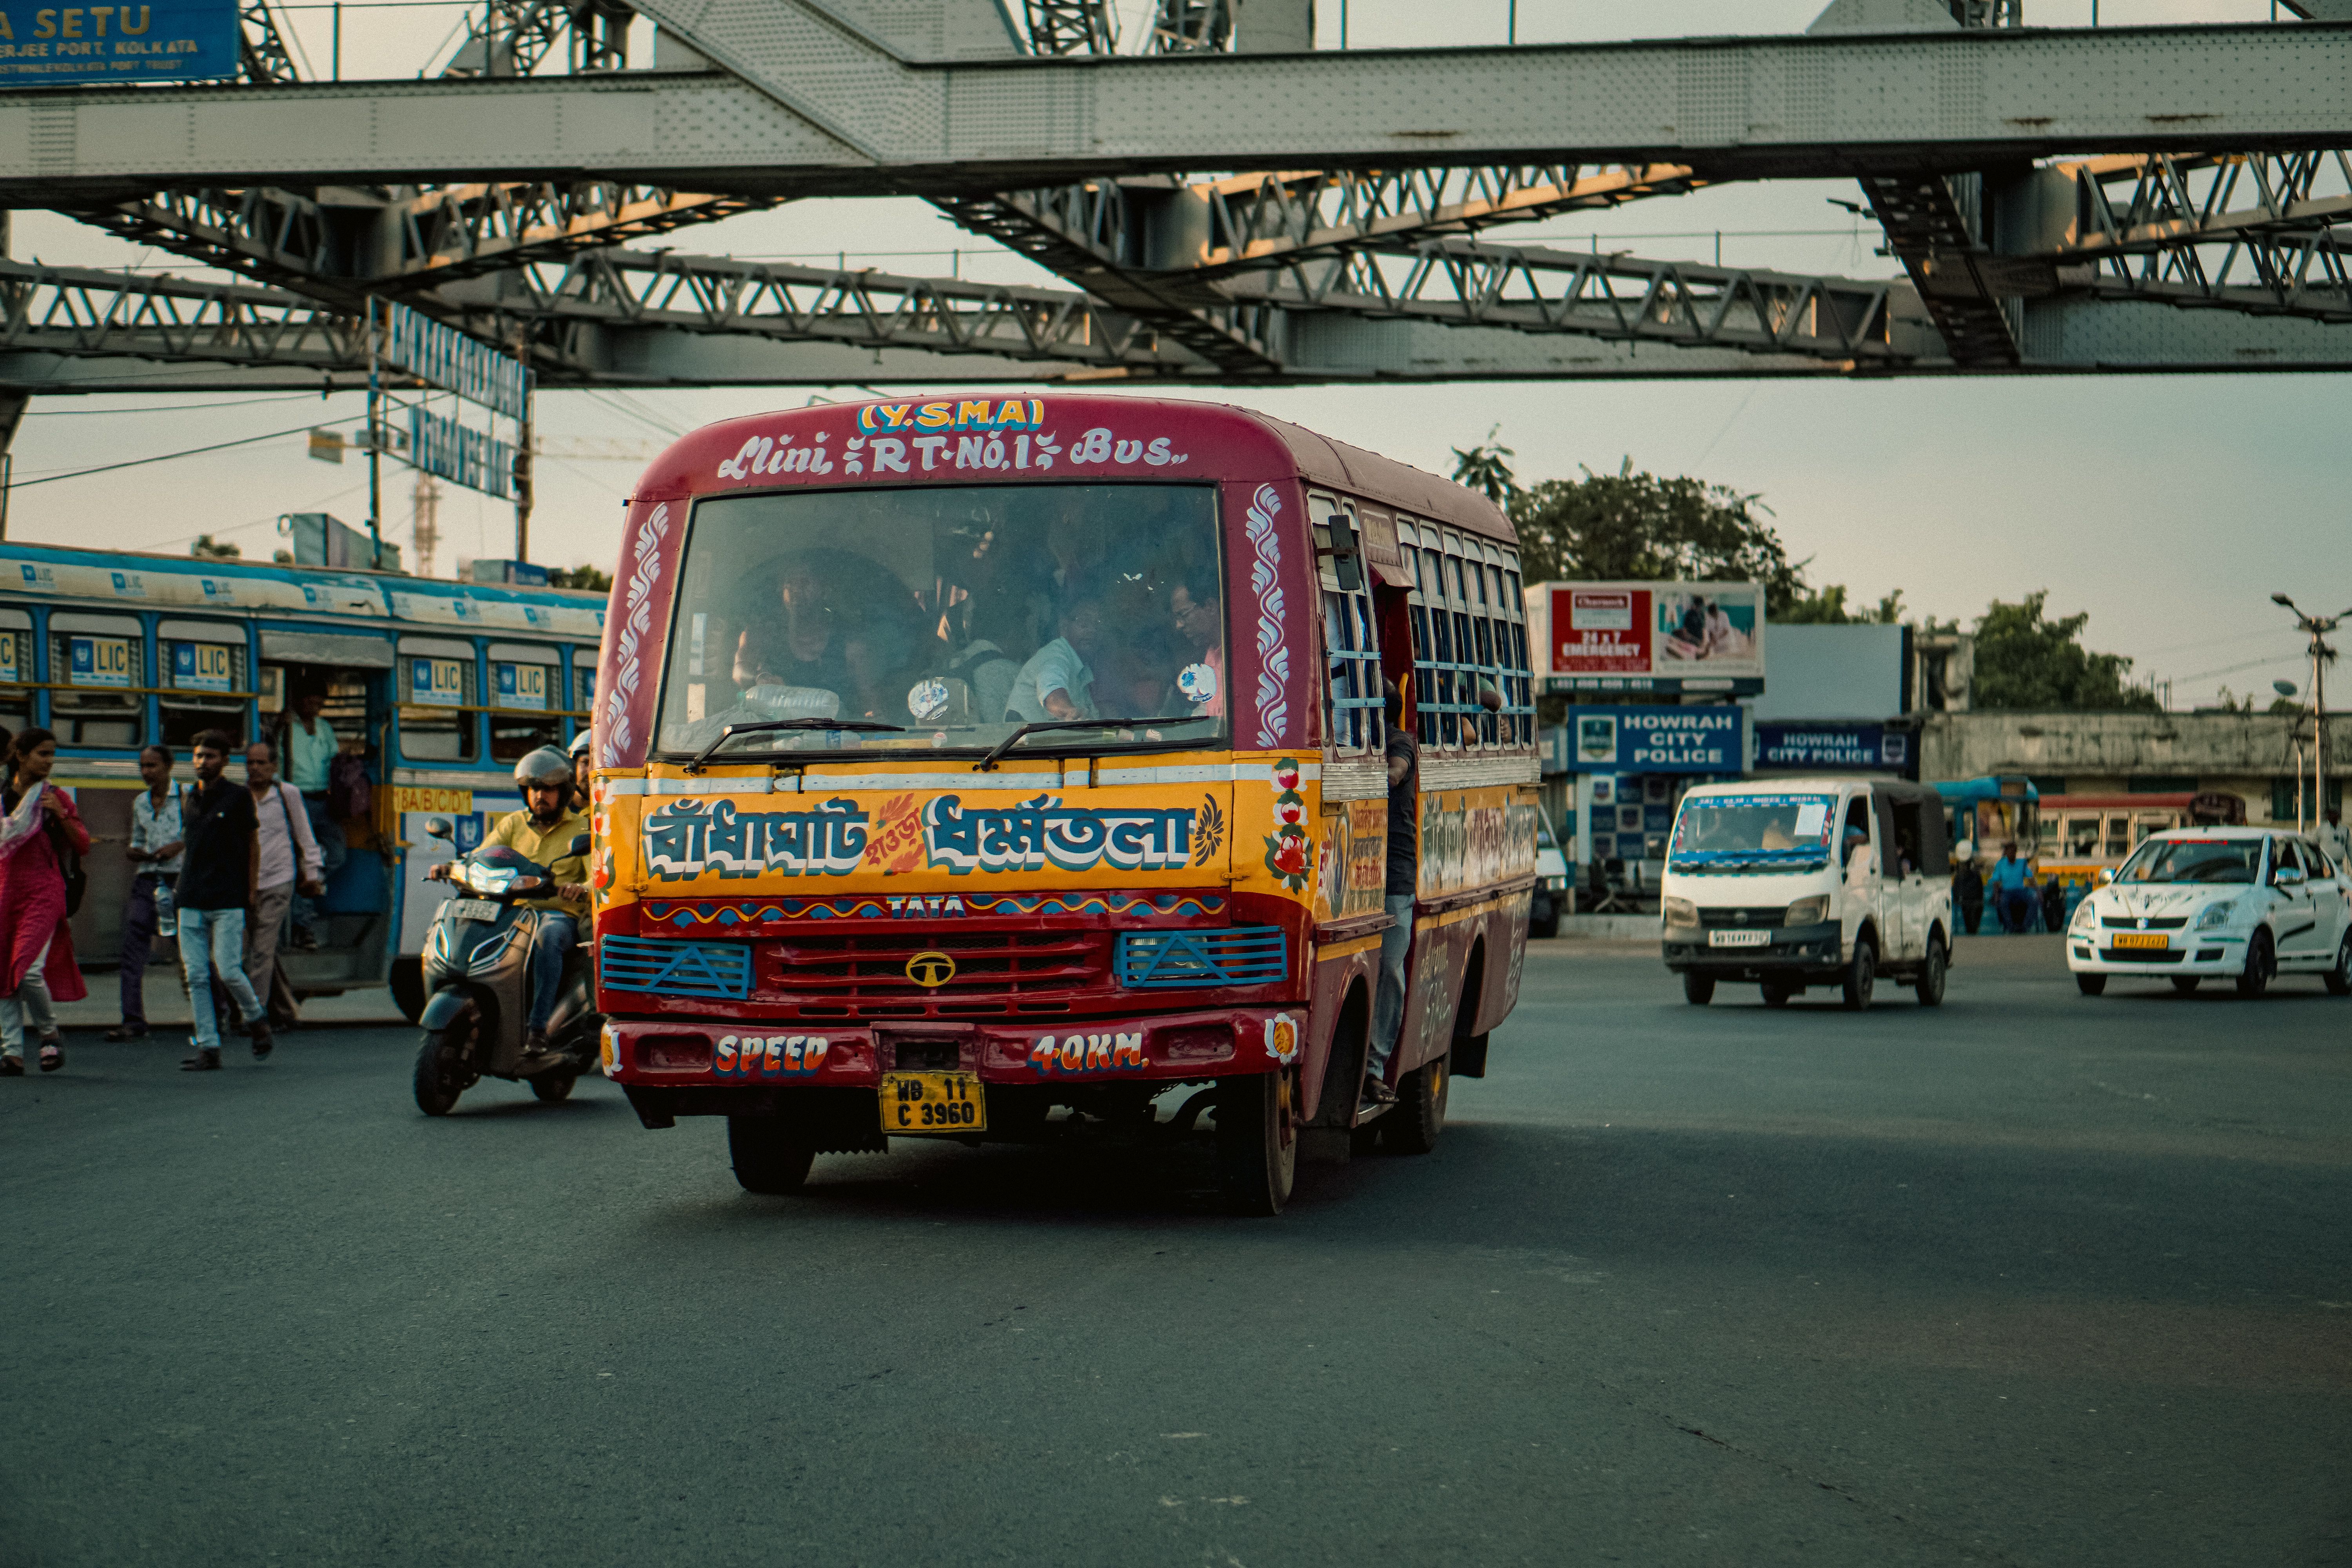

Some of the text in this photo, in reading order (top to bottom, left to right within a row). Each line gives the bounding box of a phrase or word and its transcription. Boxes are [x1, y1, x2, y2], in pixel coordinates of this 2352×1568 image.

[33, 5, 150, 38] SETU
[115, 40, 198, 54] KOLKATA
[97, 645, 125, 672] LIC
[1563, 643, 1640, 657] EMERGENCY
[200, 650, 225, 675] LIC
[435, 664, 458, 690] LIC
[519, 670, 541, 694] LIC
[1624, 715, 1732, 730] HOWRAH
[1649, 732, 1706, 746] CITY
[1783, 733, 1858, 746] HOWRAH
[1634, 748, 1722, 763] POLICE
[1768, 747, 1874, 764] CITY POLICE
[642, 797, 870, 882] বাঁধাঘাট
[864, 808, 924, 866] হাওড়া
[886, 896, 967, 918] TATA
[715, 1034, 828, 1078] SPEED
[897, 1076, 966, 1102] WB 11
[898, 1101, 975, 1127] C 3960
